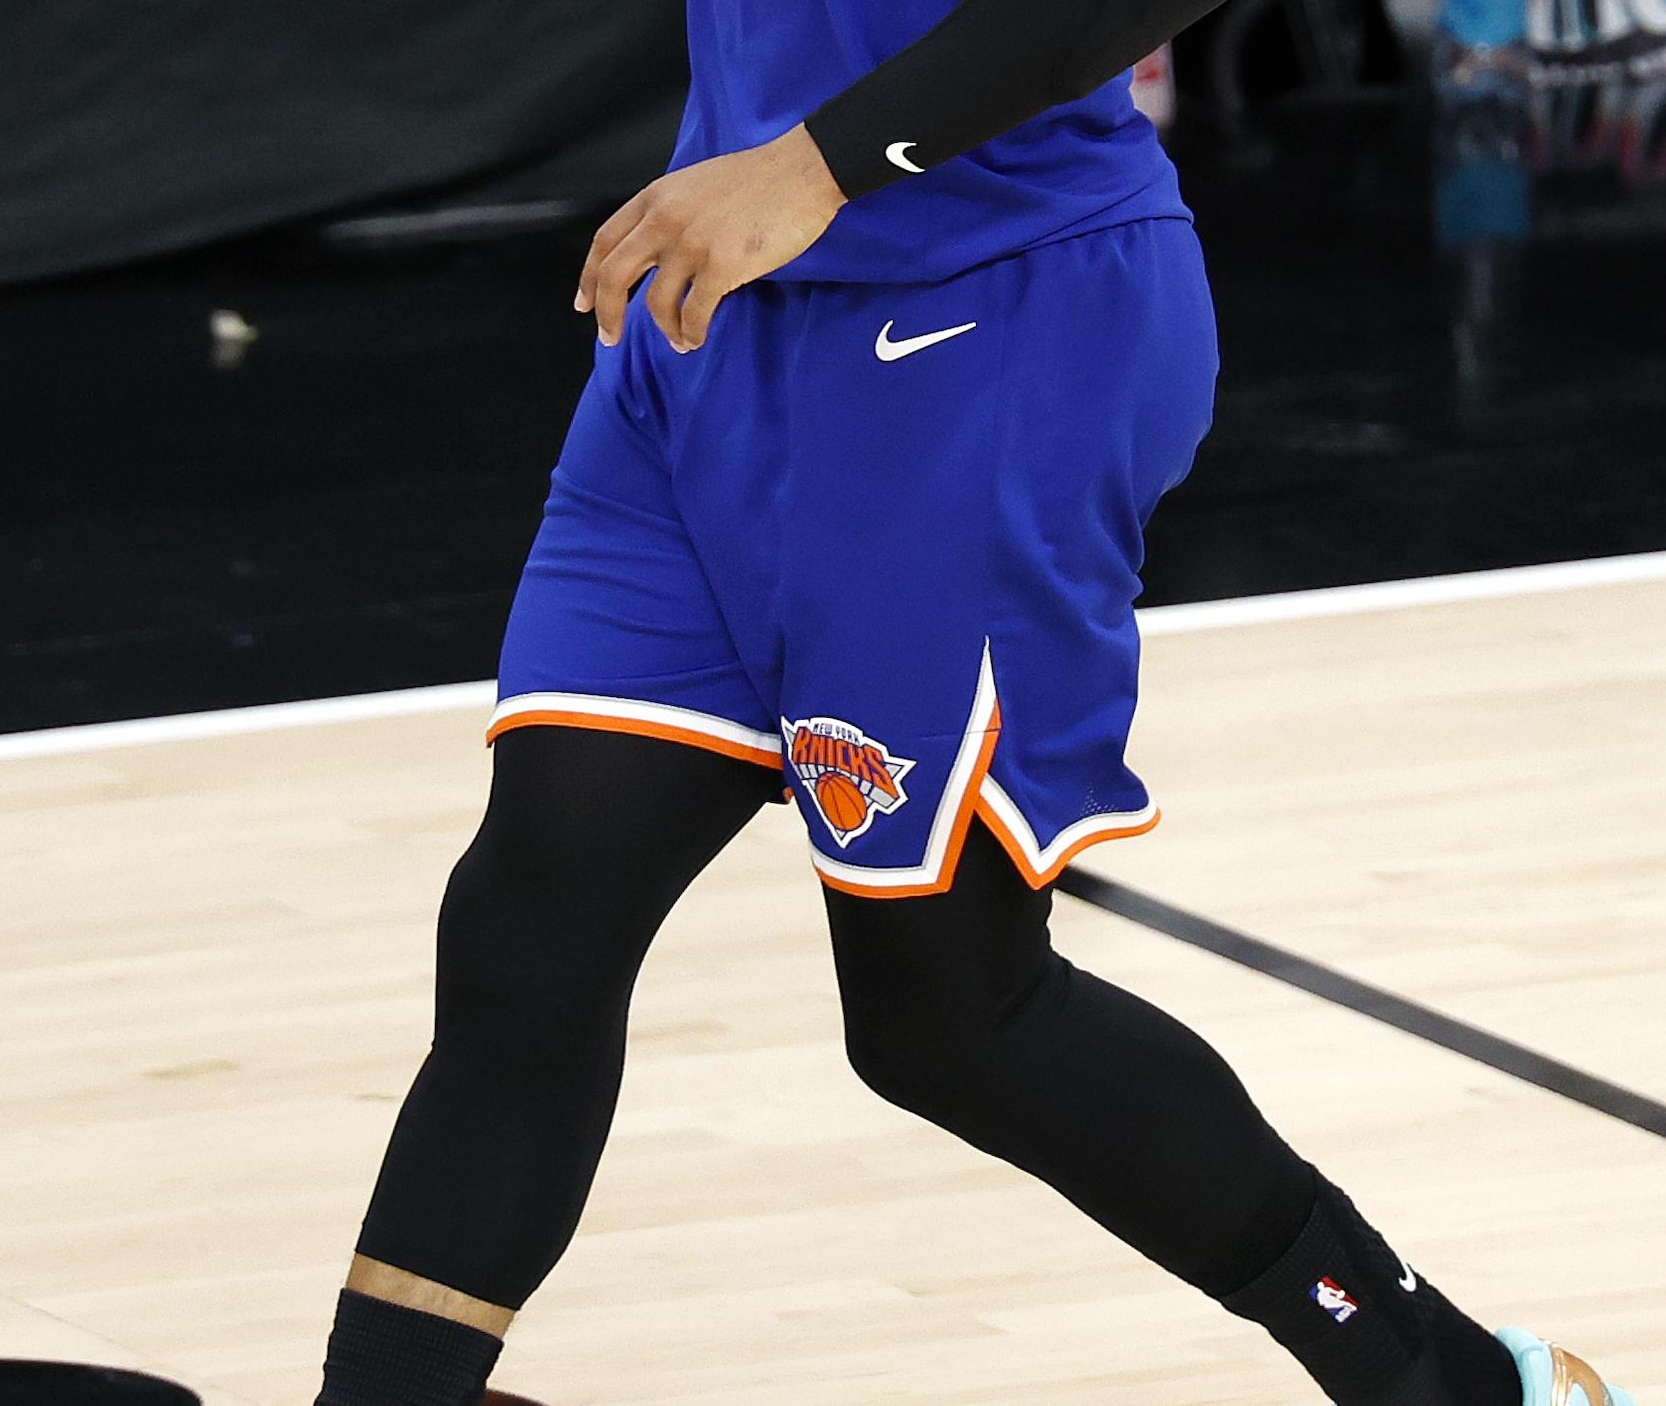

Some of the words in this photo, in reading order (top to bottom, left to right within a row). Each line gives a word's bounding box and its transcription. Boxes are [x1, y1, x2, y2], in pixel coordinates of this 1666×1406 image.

[812, 722, 833, 736] NEW
[835, 725, 861, 747] YORK
[792, 726, 900, 800] KNICKS
